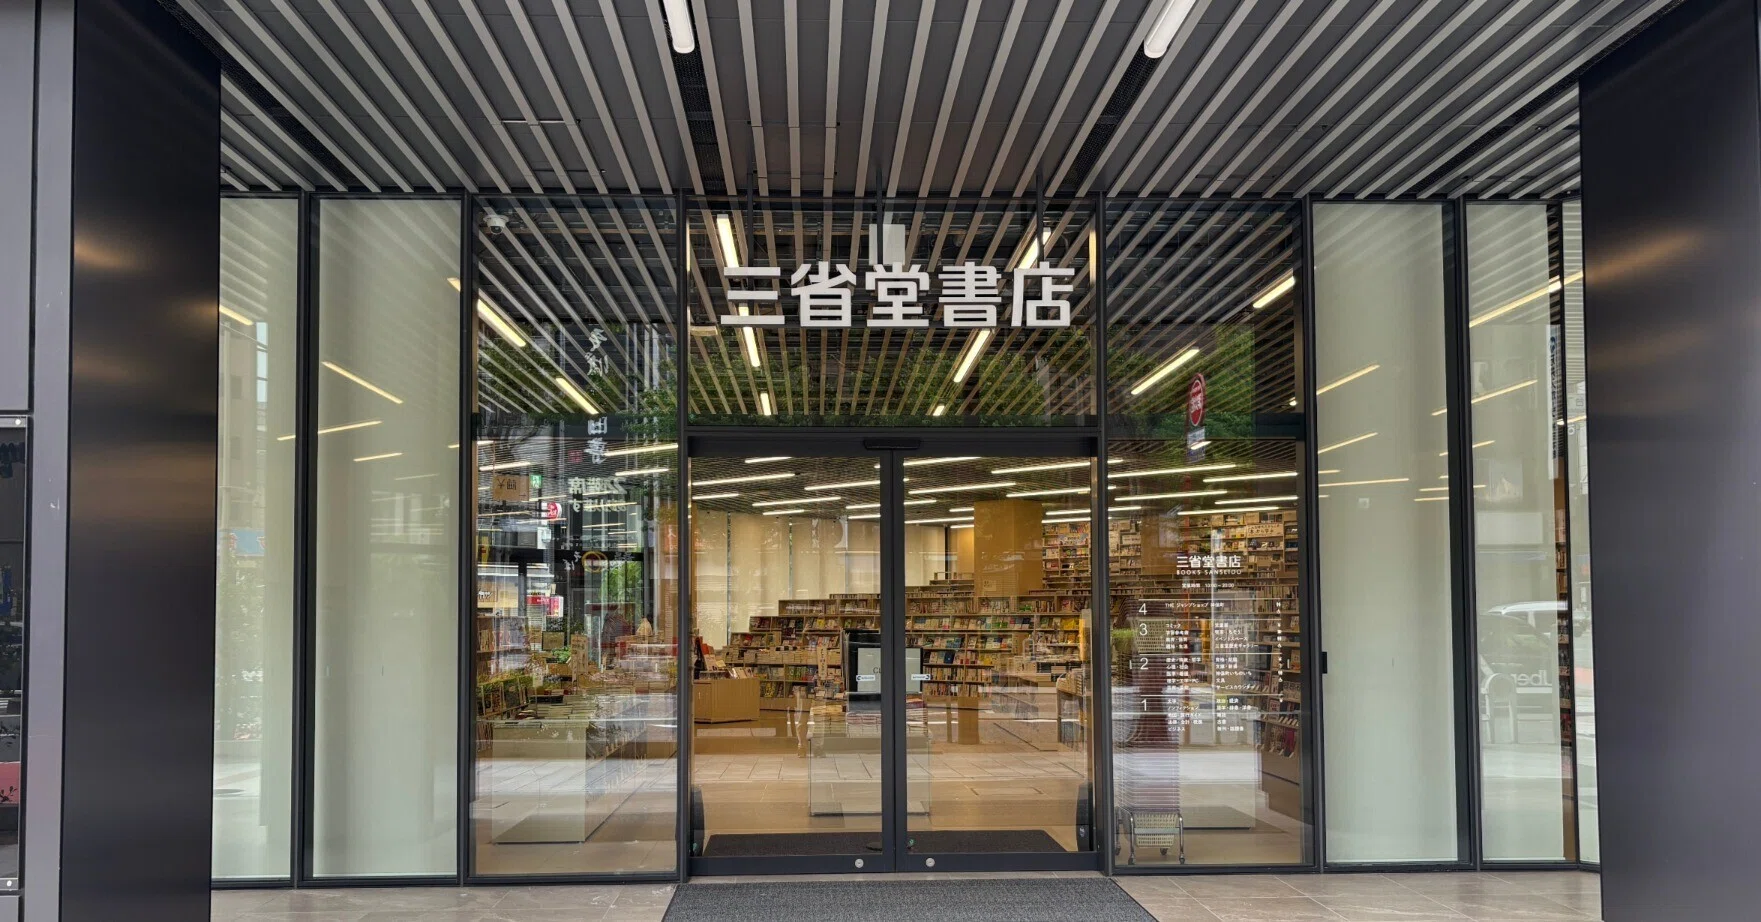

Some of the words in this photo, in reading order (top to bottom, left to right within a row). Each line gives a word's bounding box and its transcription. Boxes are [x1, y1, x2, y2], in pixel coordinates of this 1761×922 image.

[721, 261, 1075, 327] 三省堂書店
[1176, 555, 1242, 568] 三省堂書店
[1138, 603, 1148, 615] 4
[1139, 623, 1148, 636] 3
[1140, 657, 1149, 670] 2
[1141, 699, 1147, 711] 1
